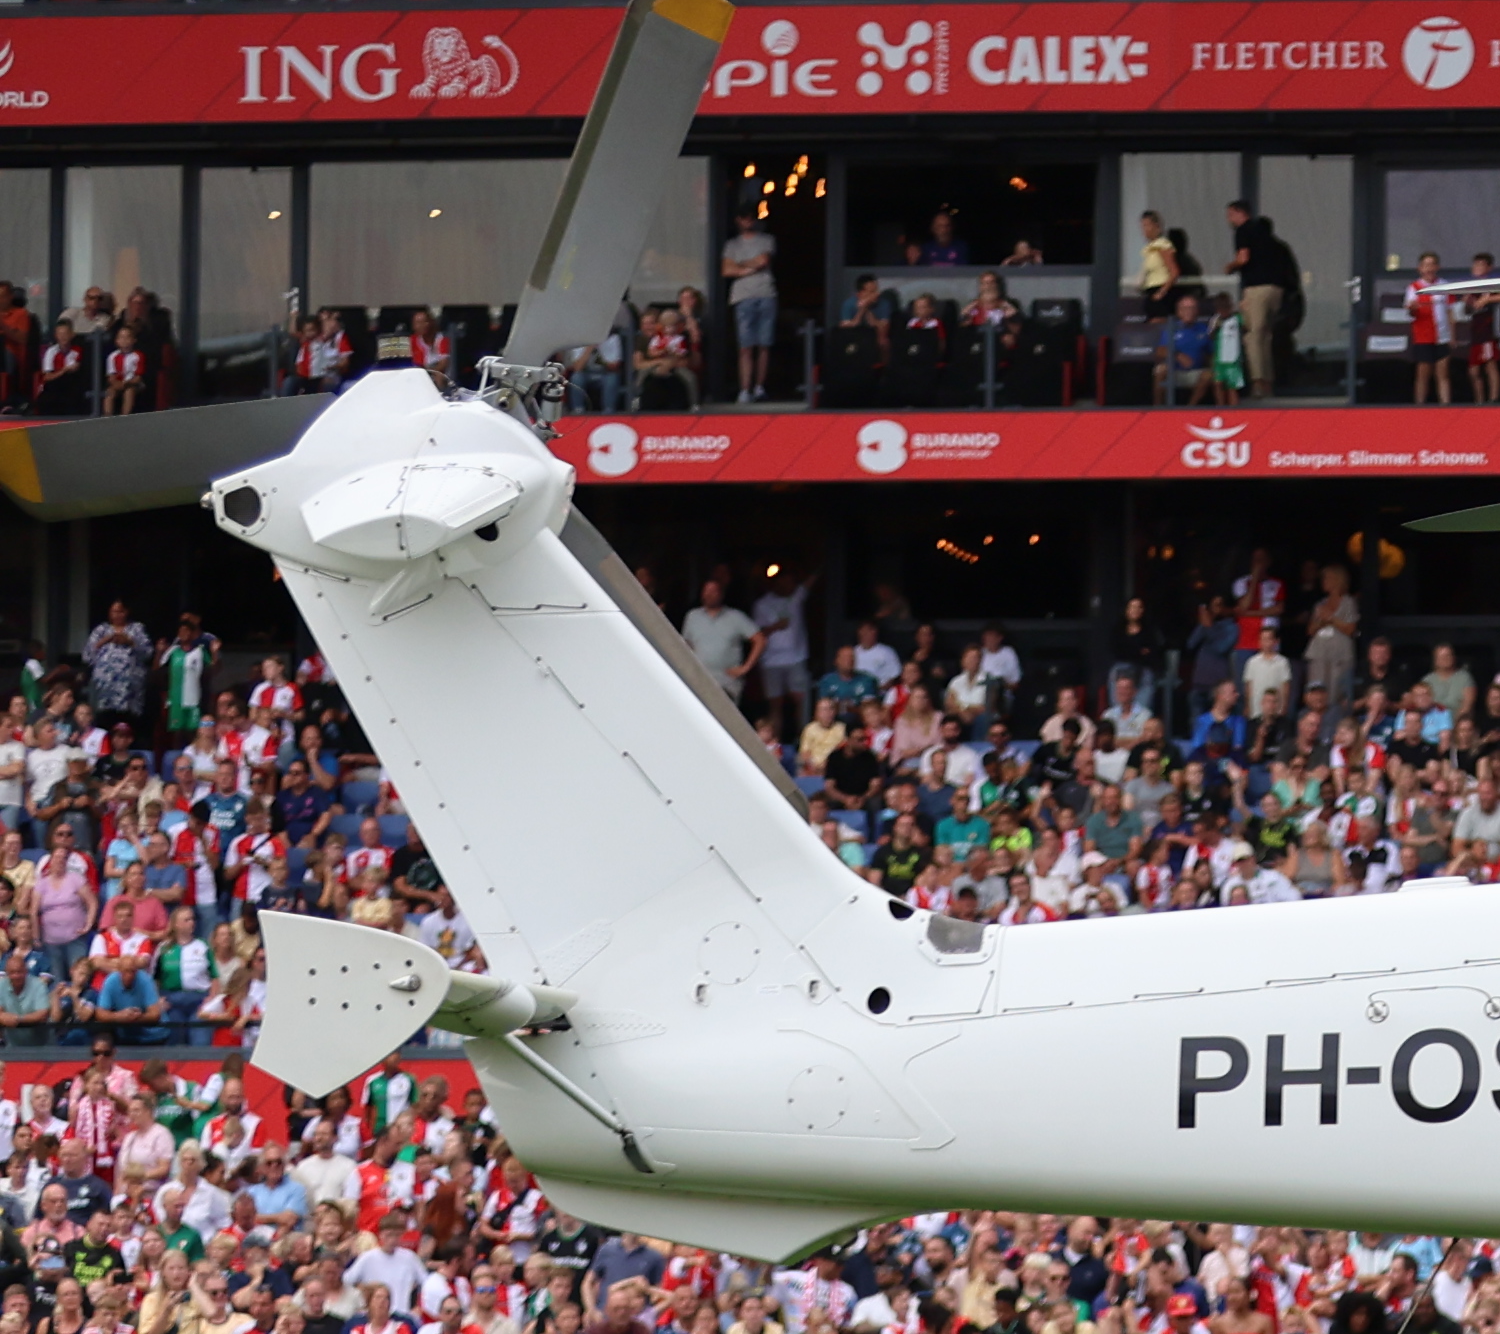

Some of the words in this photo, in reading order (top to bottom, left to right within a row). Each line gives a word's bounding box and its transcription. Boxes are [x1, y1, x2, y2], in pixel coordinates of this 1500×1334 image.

[239, 42, 401, 104] ING
[967, 35, 1133, 86] CALEX
[1191, 40, 1389, 72] FLETCHER
[702, 58, 839, 99] PIE
[0, 91, 50, 108] RLD
[1181, 440, 1251, 468] CSU
